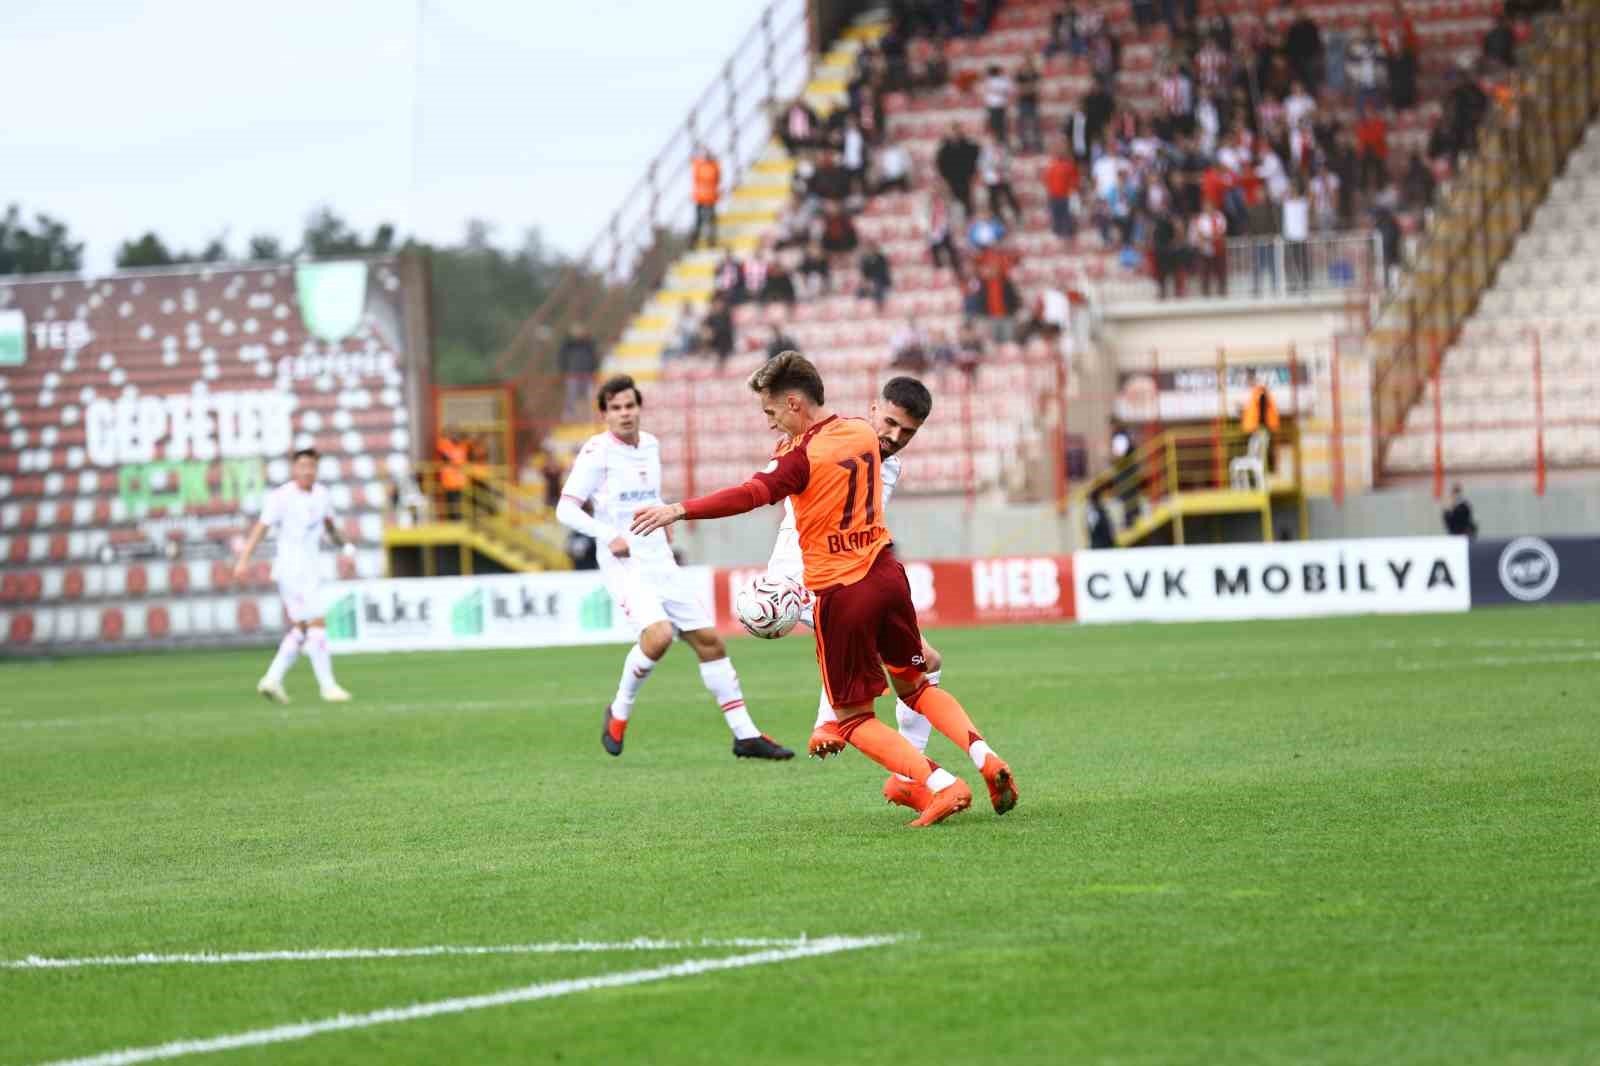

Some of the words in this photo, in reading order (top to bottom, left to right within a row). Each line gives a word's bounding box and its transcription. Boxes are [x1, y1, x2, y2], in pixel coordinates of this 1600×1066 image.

[972, 559, 1061, 608] HEB
[1086, 567, 1188, 601] CVK
[1214, 551, 1456, 597] MOBİLYA
